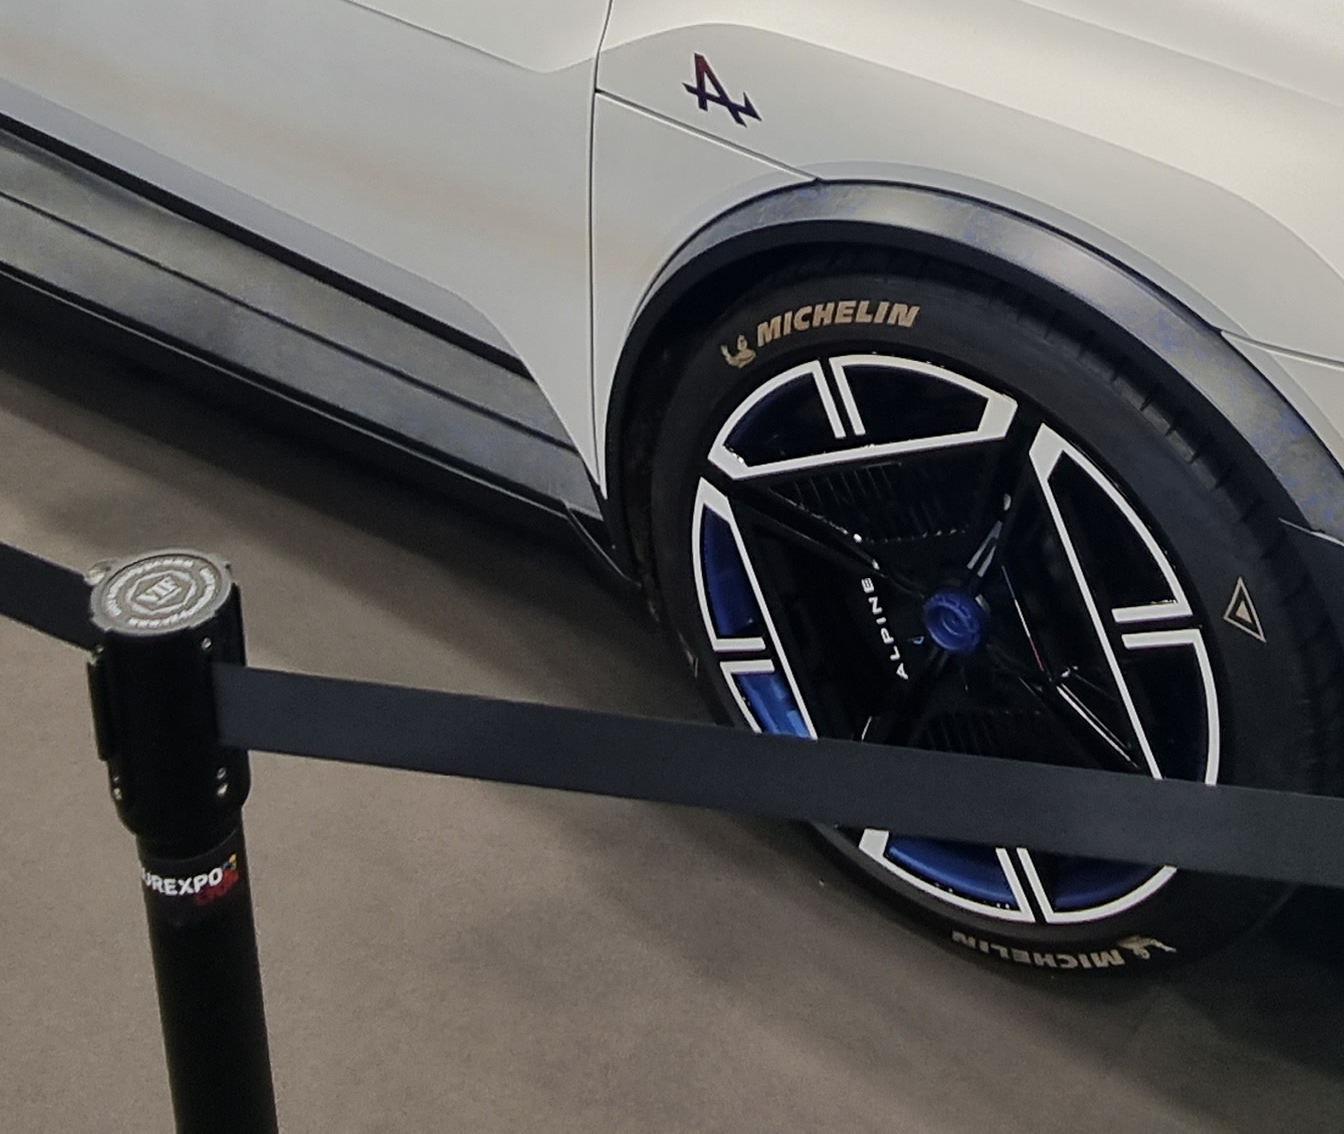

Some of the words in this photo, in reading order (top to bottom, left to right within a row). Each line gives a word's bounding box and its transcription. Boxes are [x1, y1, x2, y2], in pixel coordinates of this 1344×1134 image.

[757, 300, 920, 347] MICHELIN
[861, 578, 909, 679] ALPINE
[141, 867, 223, 895] UREXPO
[951, 930, 1125, 968] MICHELIN
